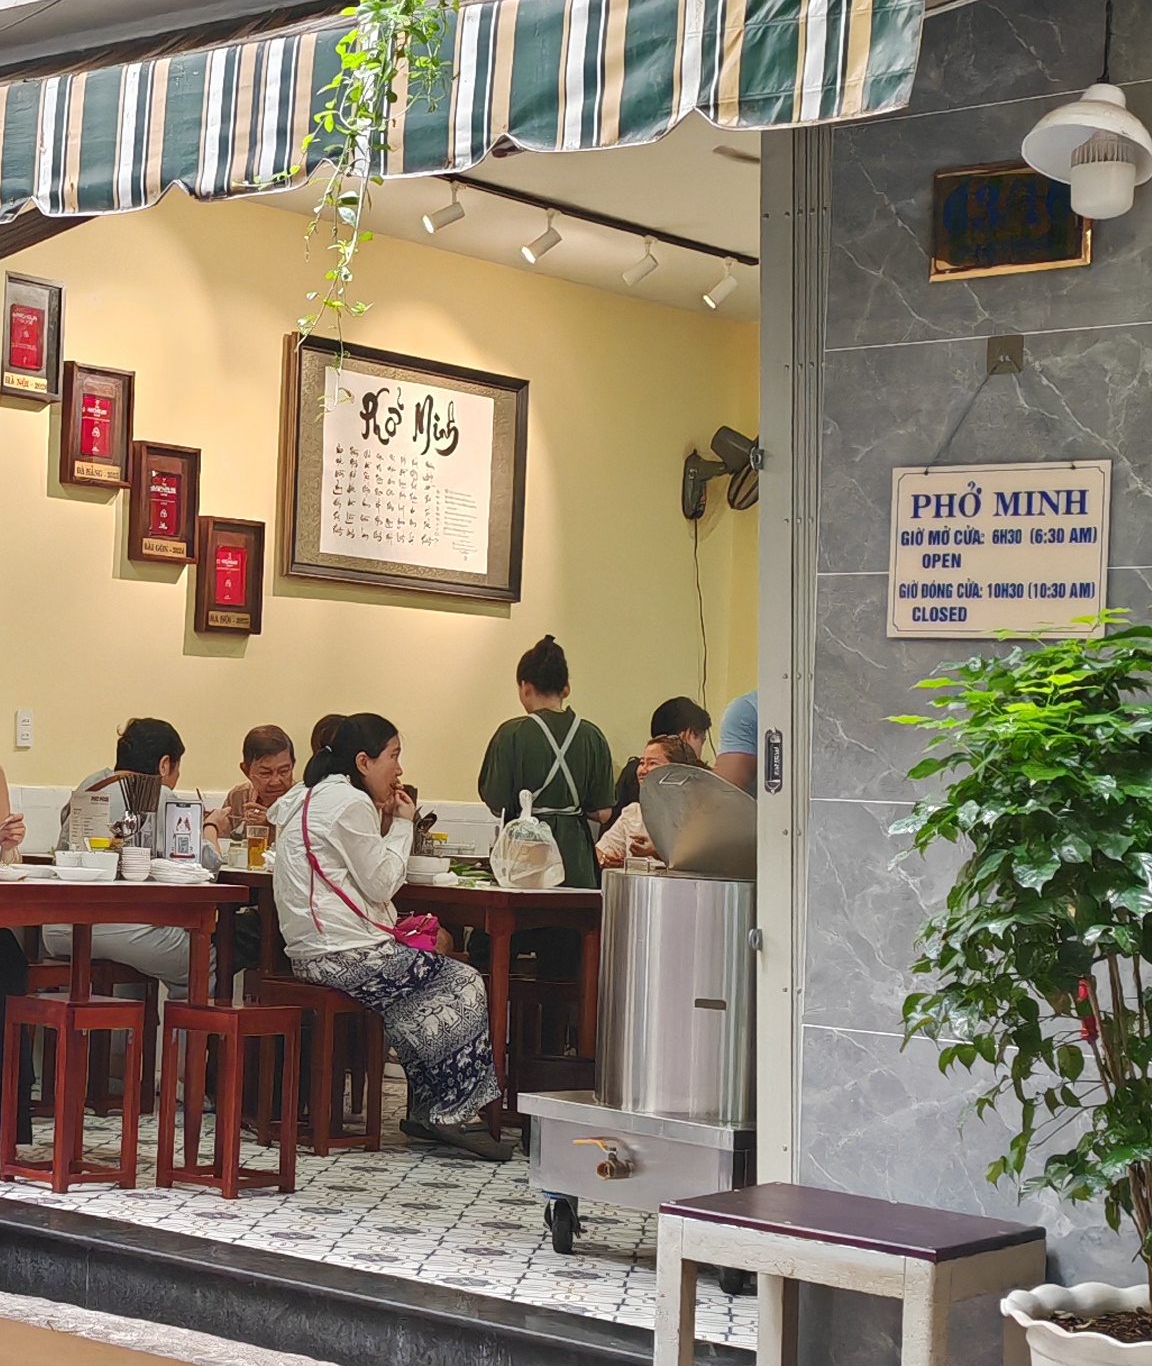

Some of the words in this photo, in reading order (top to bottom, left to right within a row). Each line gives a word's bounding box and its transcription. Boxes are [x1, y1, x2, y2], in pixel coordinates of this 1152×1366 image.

[910, 481, 983, 519] PHỞ
[992, 490, 1089, 517] MINH
[901, 527, 925, 546] GIỜ
[928, 525, 951, 546] MỞ
[992, 529, 1022, 545] 6H30
[1030, 528, 1065, 545] (6:30
[1068, 527, 1098, 545] AM)
[922, 553, 962, 568] OPEN
[899, 579, 918, 599] GIỜ
[921, 579, 953, 599] ĐÓNG
[987, 582, 1024, 599] 10H30
[1028, 582, 1066, 599] (10:30
[1069, 582, 1096, 599] AM)
[912, 606, 967, 622] CLOSED
